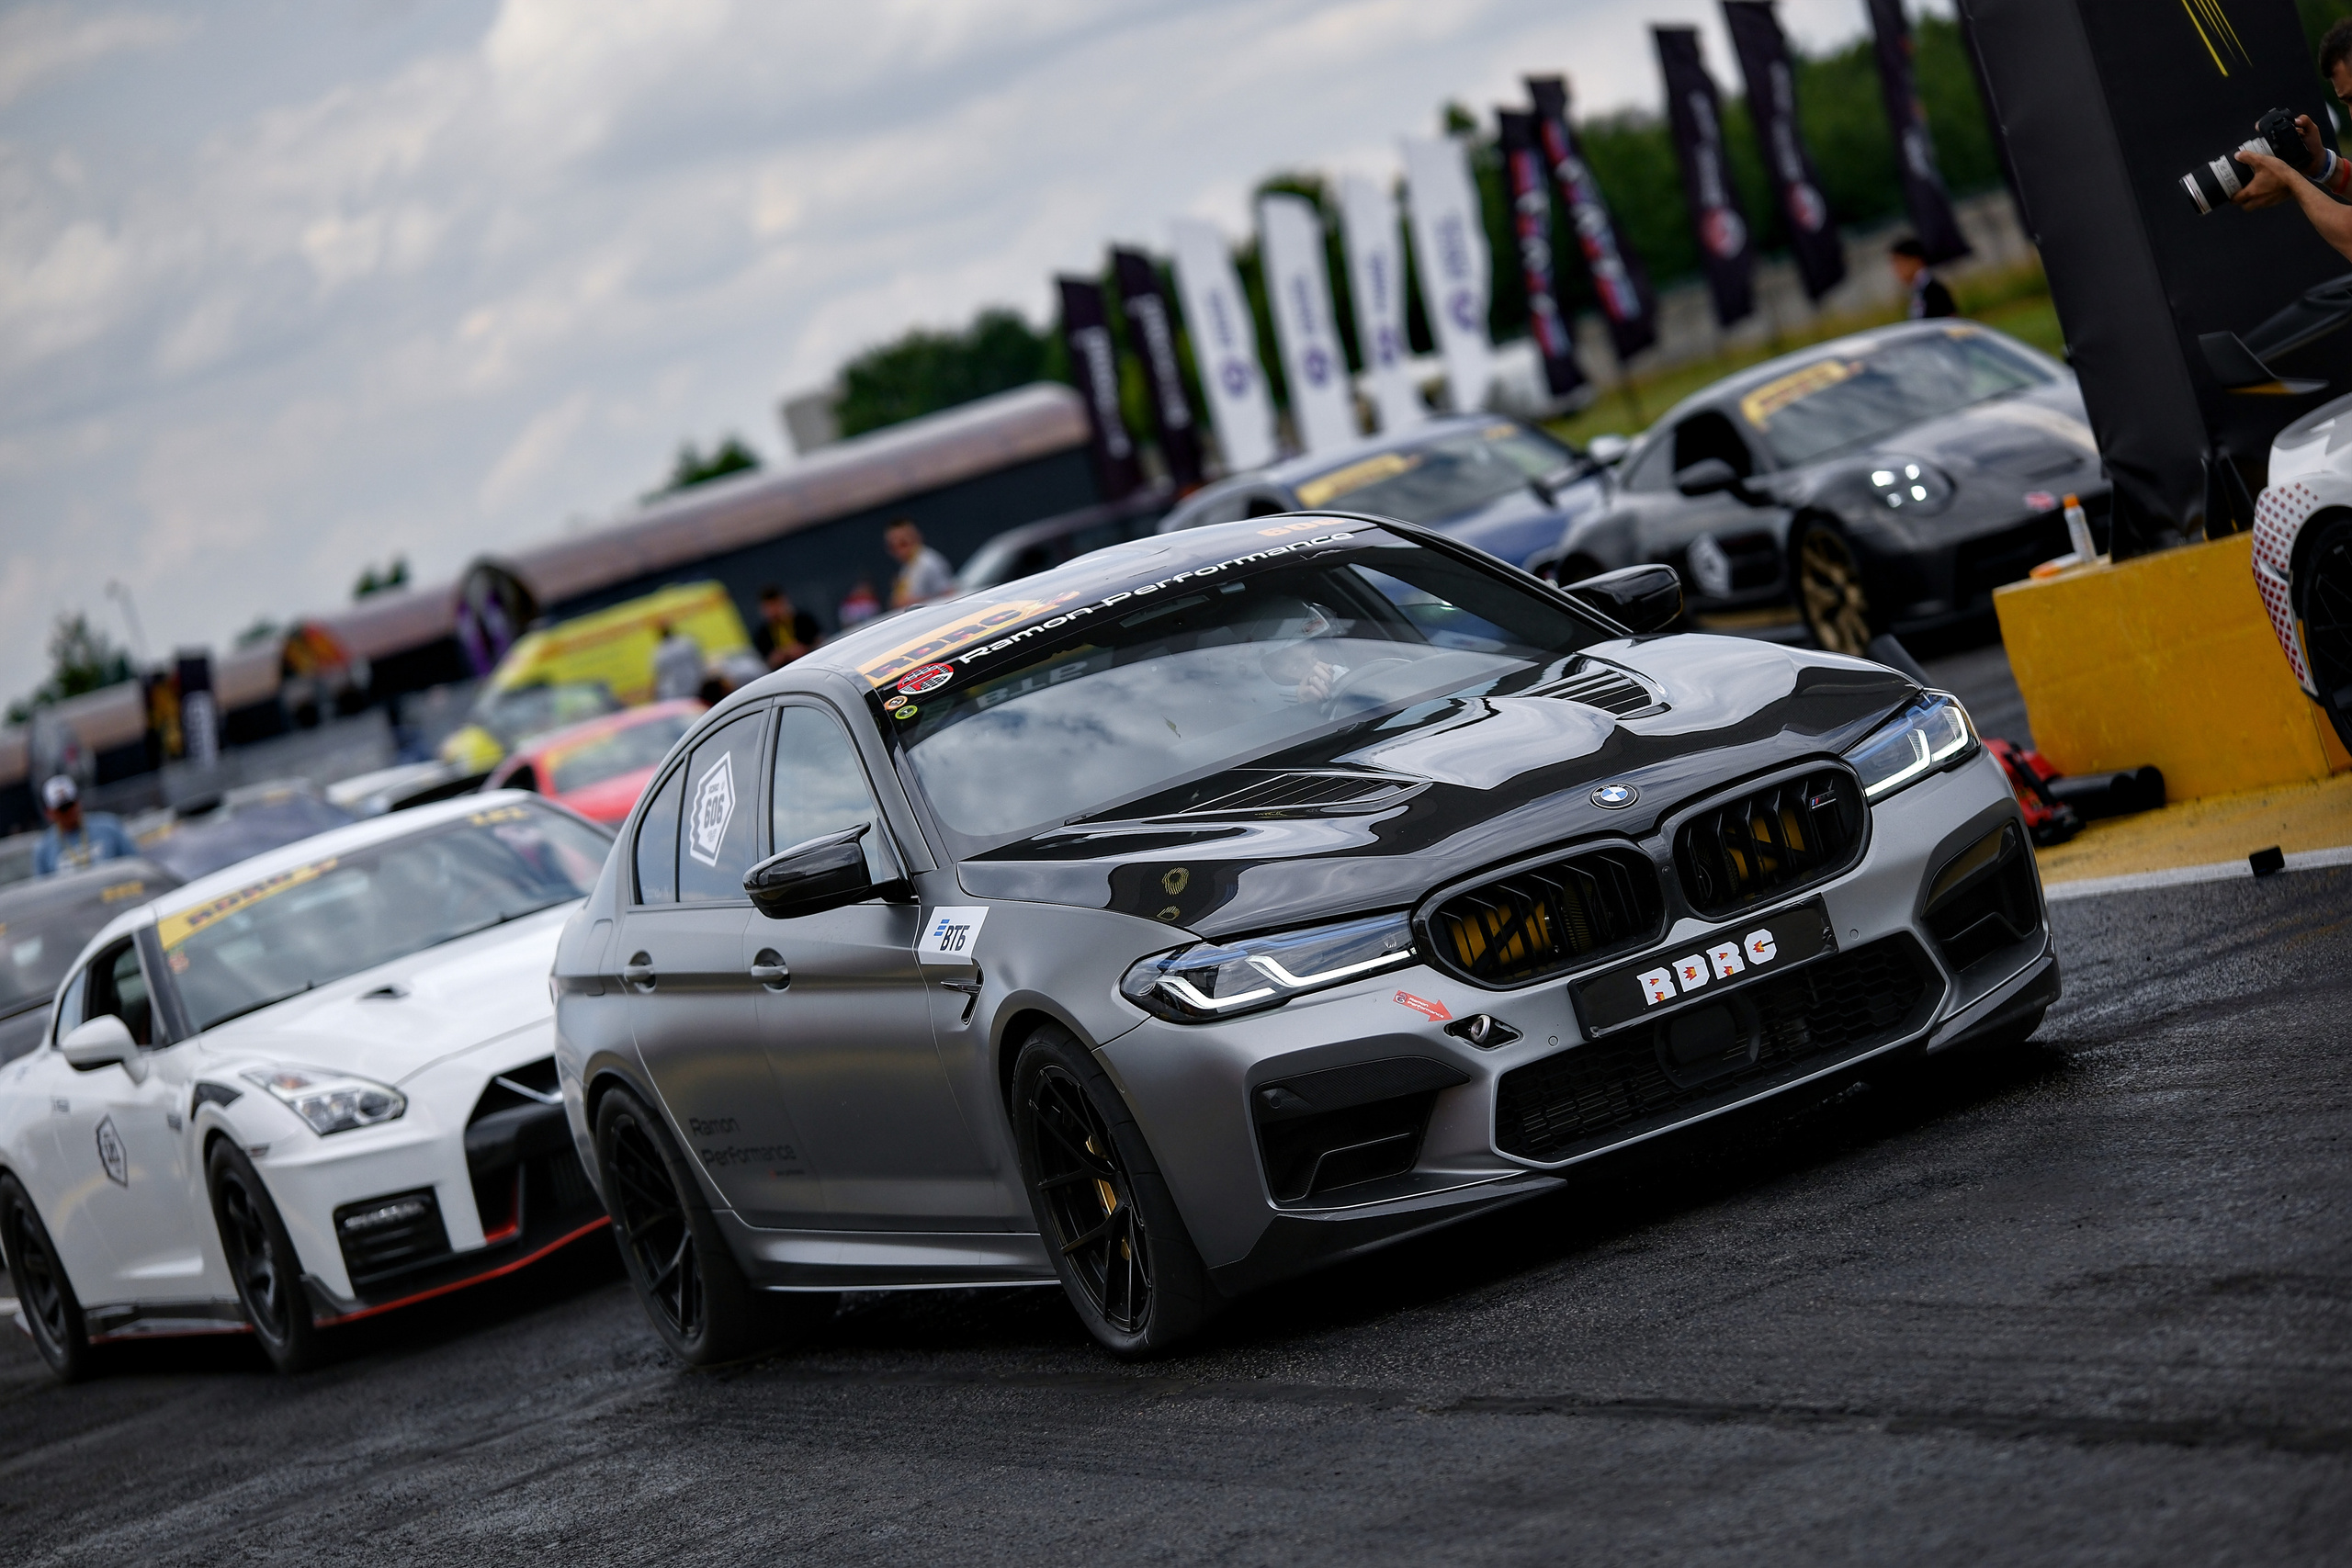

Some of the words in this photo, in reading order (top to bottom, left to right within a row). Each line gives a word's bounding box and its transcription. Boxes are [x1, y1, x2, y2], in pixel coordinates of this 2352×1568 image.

[1257, 517, 1347, 537] 606
[958, 606, 1094, 664] Ramon
[1102, 531, 1355, 607] Performance
[865, 608, 1023, 679] RDRC
[704, 793, 725, 829] 606
[1635, 928, 1778, 1006] RDRC
[1407, 1000, 1444, 1019] Performance
[1408, 997, 1430, 1008] Ramon
[689, 1116, 741, 1137] Ramon
[700, 1144, 797, 1168] Performance
